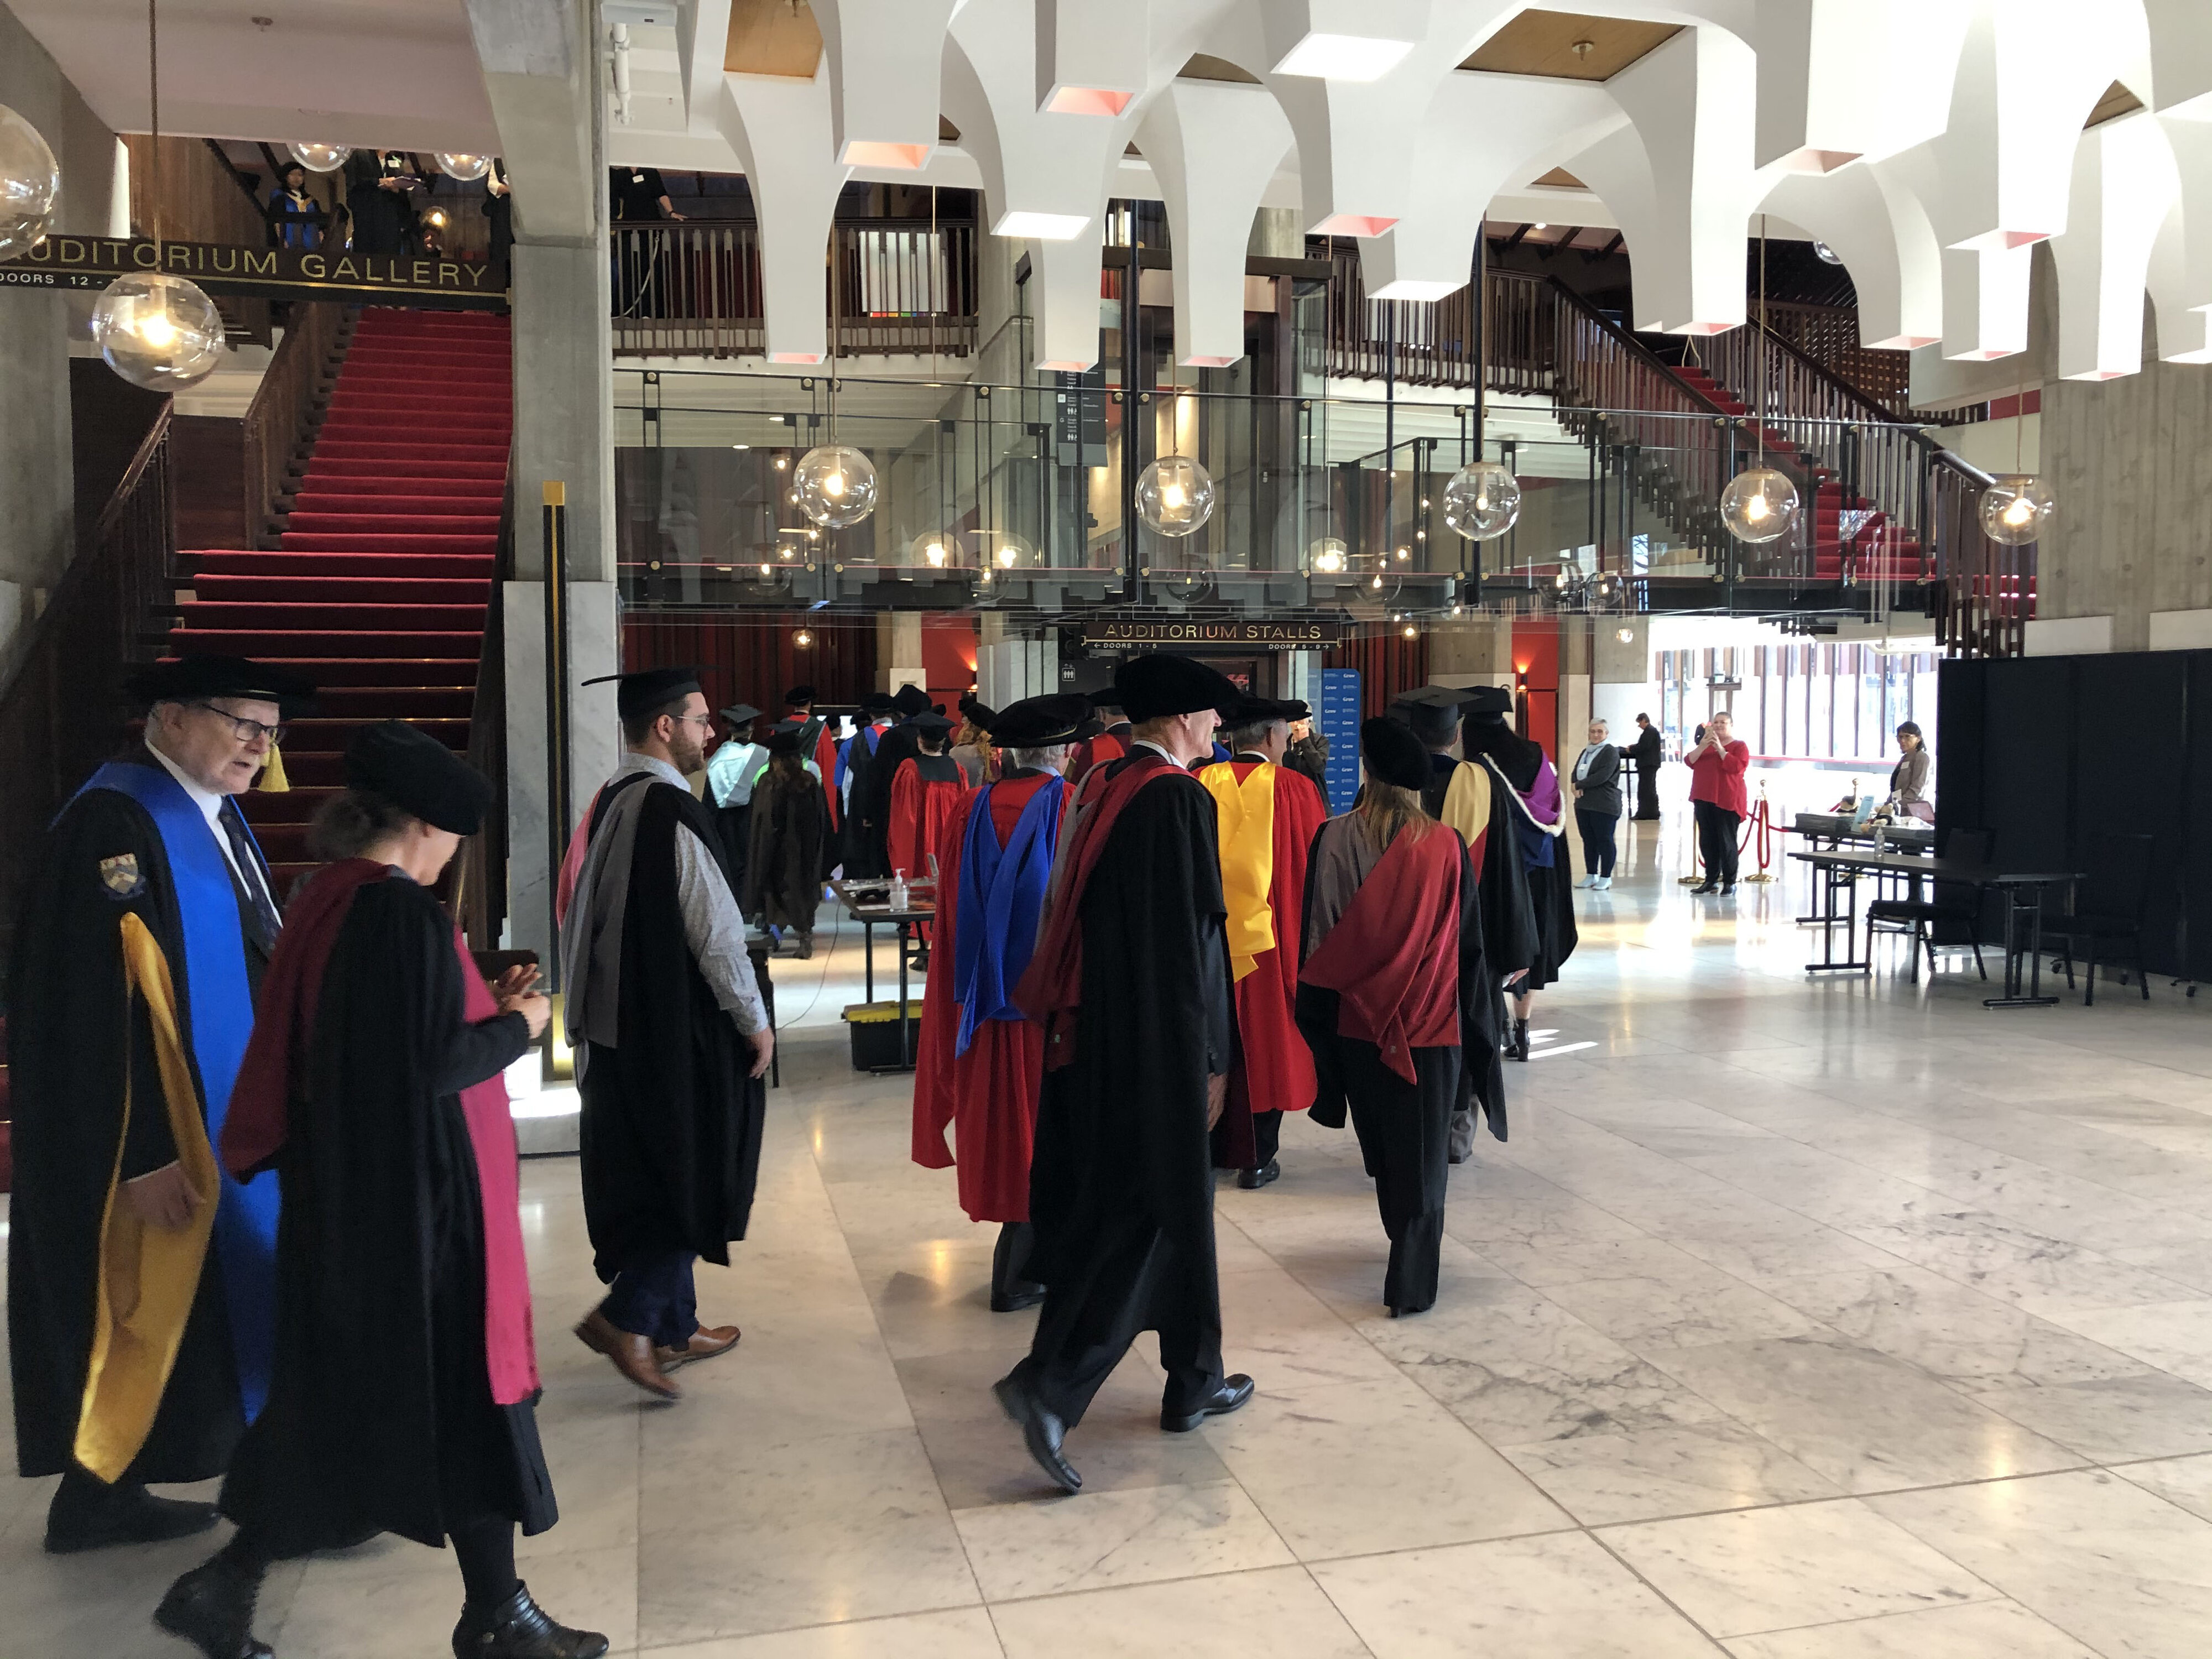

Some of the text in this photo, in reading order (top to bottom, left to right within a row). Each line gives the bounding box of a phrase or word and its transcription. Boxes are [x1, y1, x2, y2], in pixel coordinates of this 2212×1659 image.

[14, 238, 487, 286] UDITORIUM GALLERY
[70, 276, 88, 286] 12
[1104, 624, 1321, 639] AUDITORIUM STALLS
